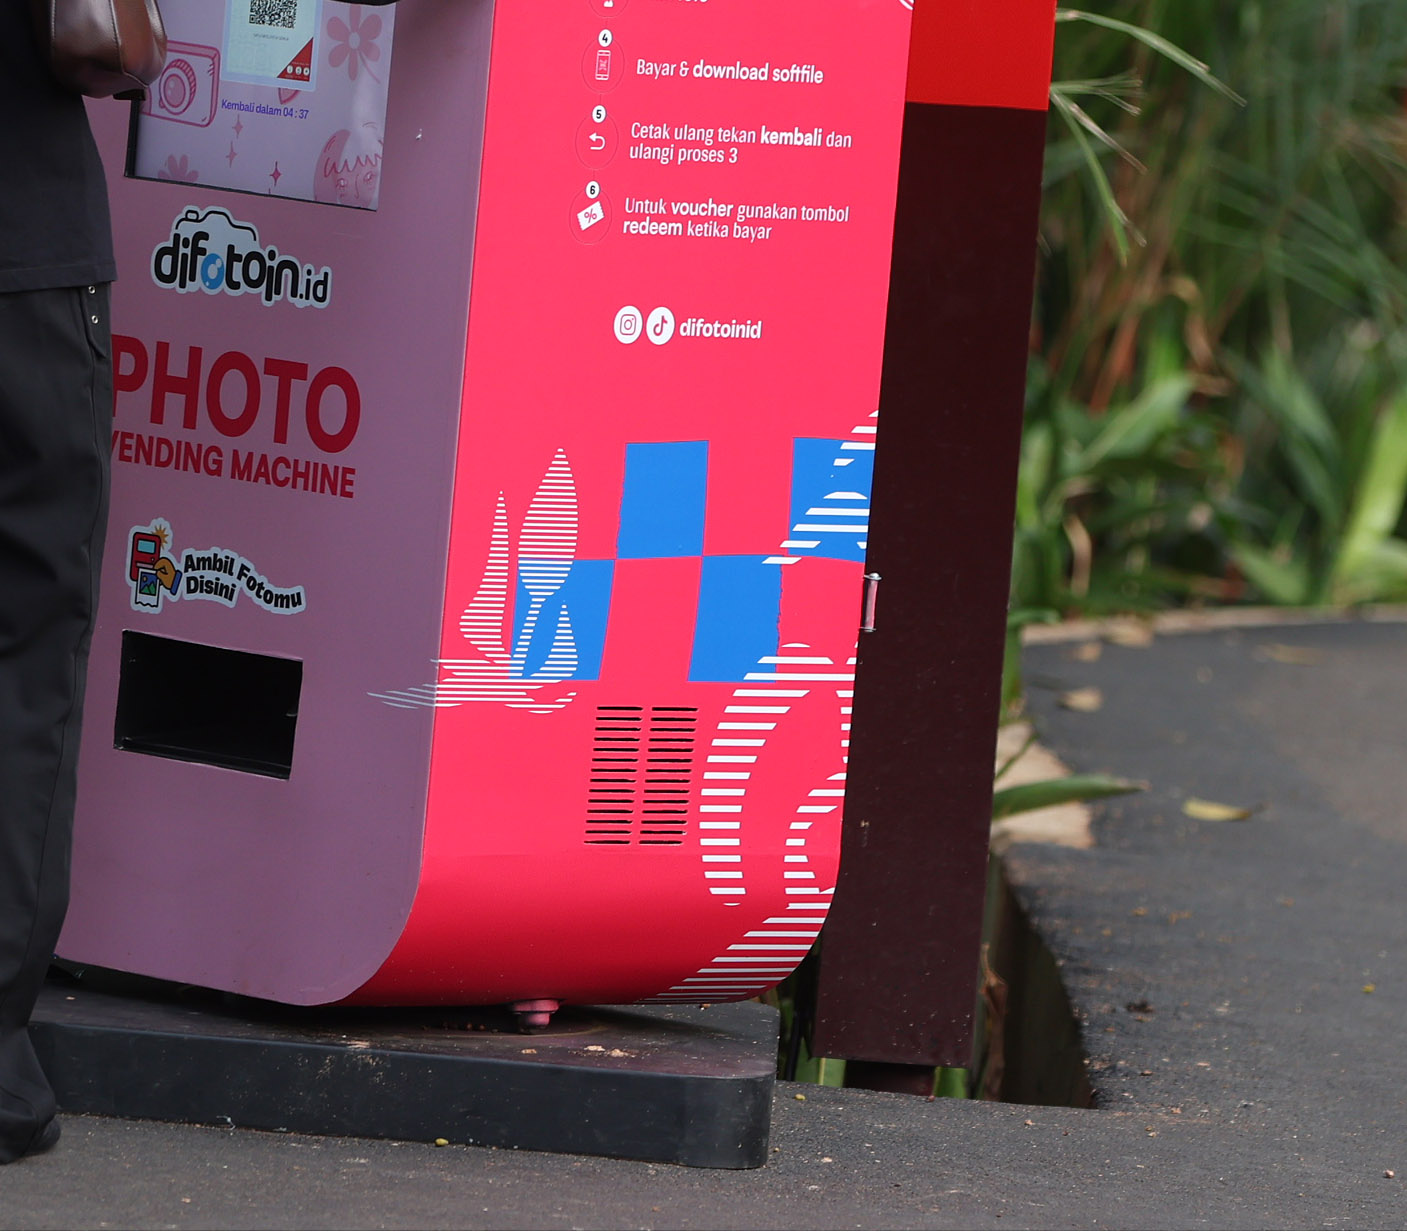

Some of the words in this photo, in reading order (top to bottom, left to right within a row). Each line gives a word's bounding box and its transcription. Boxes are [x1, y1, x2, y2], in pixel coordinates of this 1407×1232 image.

[601, 33, 609, 44] 4
[636, 58, 676, 80] Bayar
[679, 61, 690, 77] &
[692, 59, 769, 81] download
[772, 63, 824, 84] softfile
[221, 99, 255, 113] Kembali
[255, 103, 282, 116] dalam
[283, 107, 294, 117] 04
[298, 109, 310, 119] 37
[595, 108, 602, 119] 5
[630, 121, 671, 140] Cetak
[674, 124, 715, 145] ulang
[717, 125, 756, 144] tekan
[760, 125, 823, 147] kembali
[826, 131, 852, 148] dan
[629, 143, 674, 164] ulangi
[677, 148, 724, 166] proses
[729, 147, 738, 163] 3
[589, 184, 596, 195] 6
[624, 197, 667, 215] Untuk
[671, 198, 734, 218] voucher
[736, 202, 797, 222] gunakan
[800, 205, 850, 222] tombol
[622, 216, 683, 236] redeem
[686, 220, 729, 238] ketika
[732, 221, 772, 243] bayar
[154, 230, 329, 303] difotoin.id
[679, 318, 762, 339] difotoinid
[111, 333, 361, 454] PHOTO
[230, 448, 356, 499] MACHINE
[183, 553, 235, 576] Ambil
[236, 563, 302, 609] Fotomu
[186, 575, 236, 602] Disini
